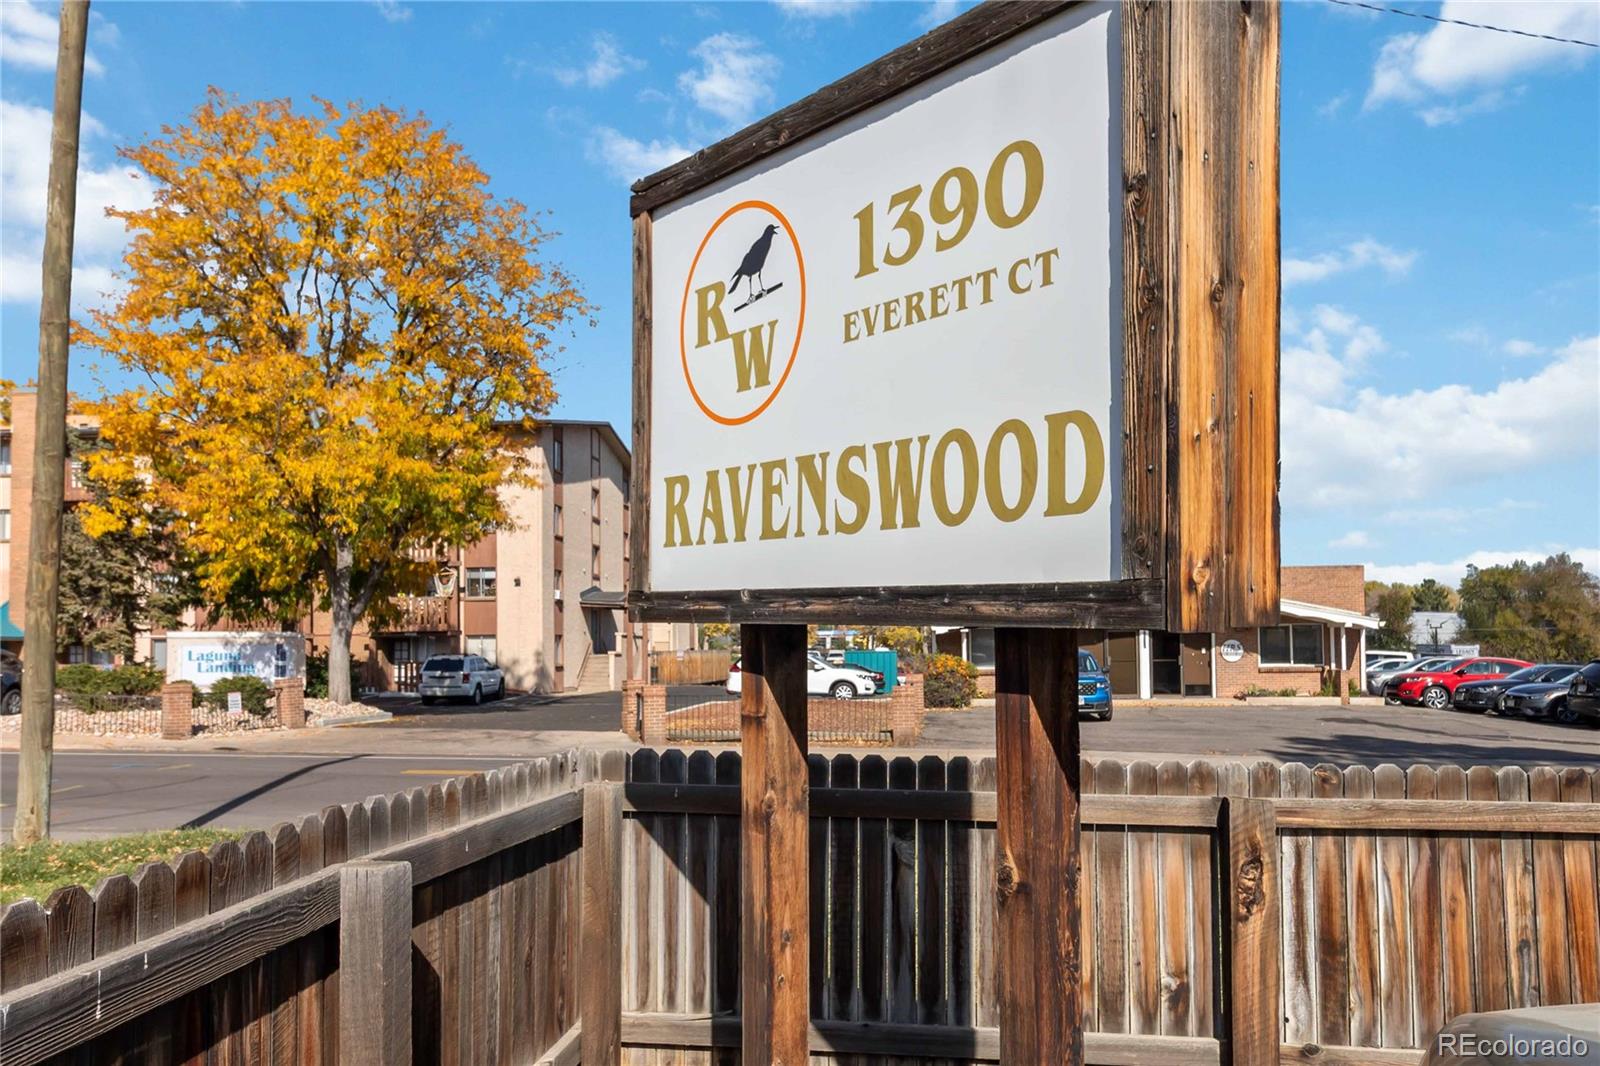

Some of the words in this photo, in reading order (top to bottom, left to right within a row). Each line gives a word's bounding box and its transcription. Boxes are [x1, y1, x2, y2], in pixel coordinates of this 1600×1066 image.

[853, 140, 1043, 278] 1390
[695, 280, 731, 348] R
[843, 267, 998, 343] EVERETT
[1007, 248, 1060, 295] CT
[729, 319, 778, 393] W
[664, 409, 1105, 548] RAVENSWOOD
[188, 650, 242, 662] Laguna
[197, 662, 256, 674] Landing
